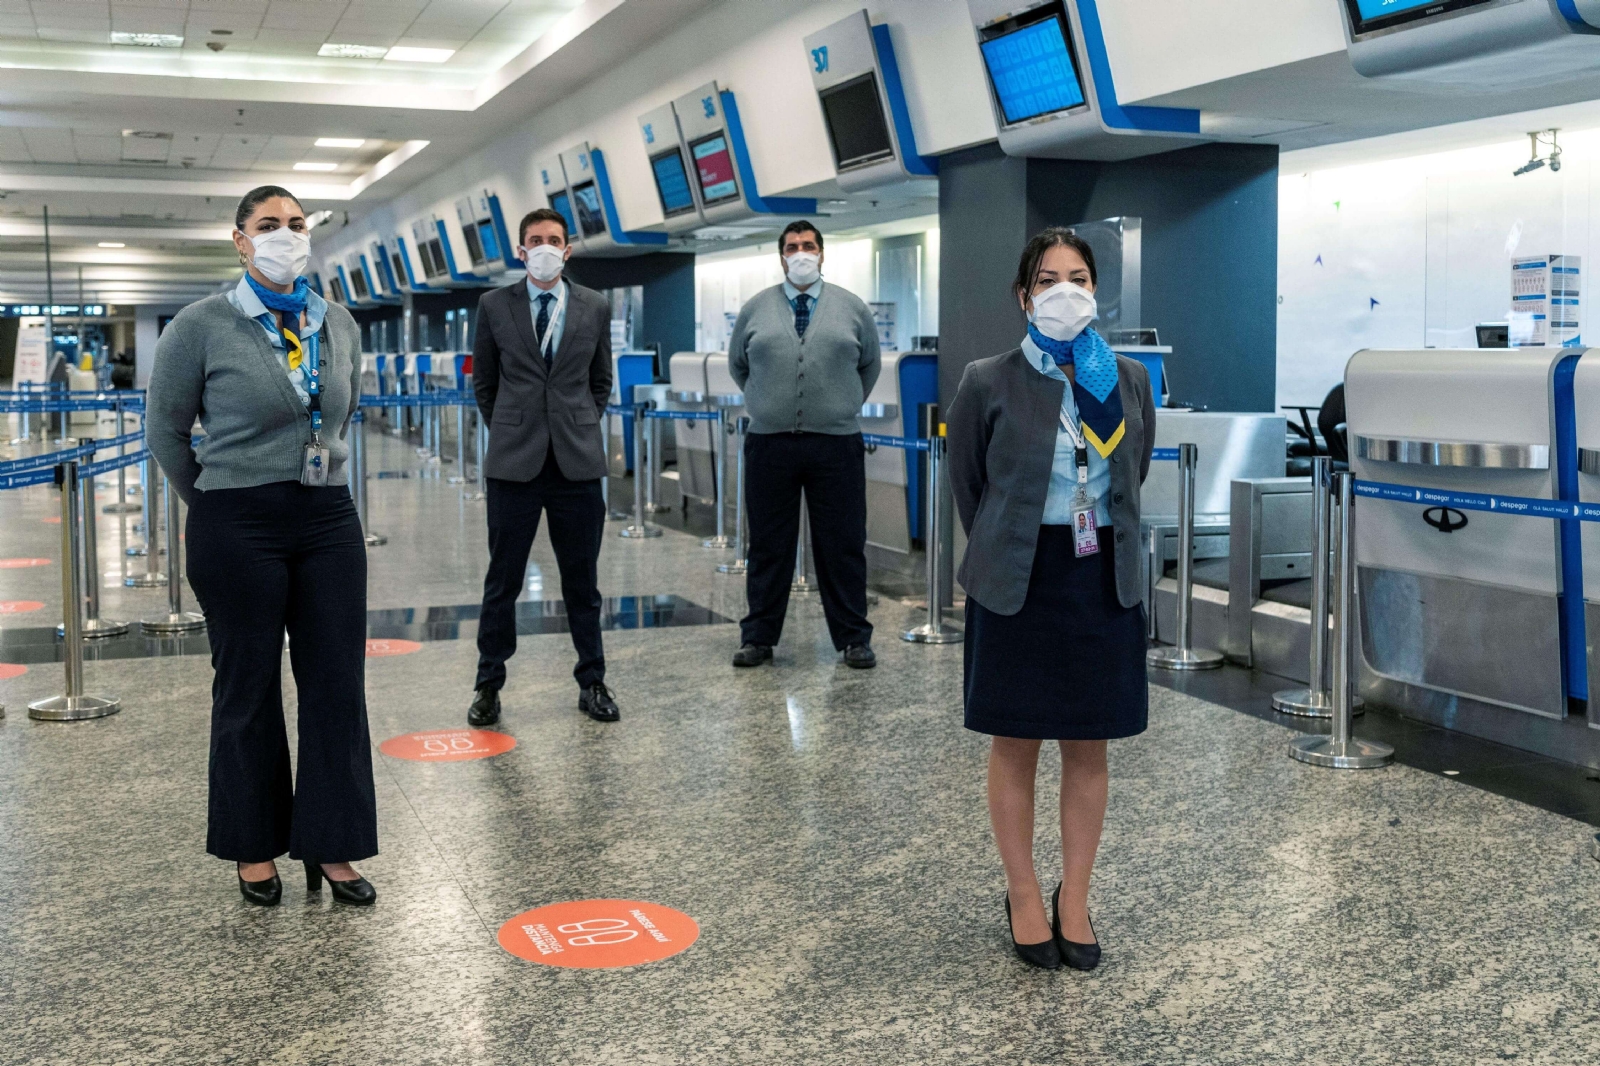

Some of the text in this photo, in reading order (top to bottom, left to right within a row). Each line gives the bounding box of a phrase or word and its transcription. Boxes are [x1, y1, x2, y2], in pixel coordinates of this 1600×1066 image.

[811, 45, 829, 73] 37
[1356, 484, 1380, 494] despegar
[1424, 493, 1450, 502] despegar
[1500, 501, 1528, 511] despegar
[520, 924, 554, 956] DISTANCIA
[533, 923, 565, 954] MANTENGA
